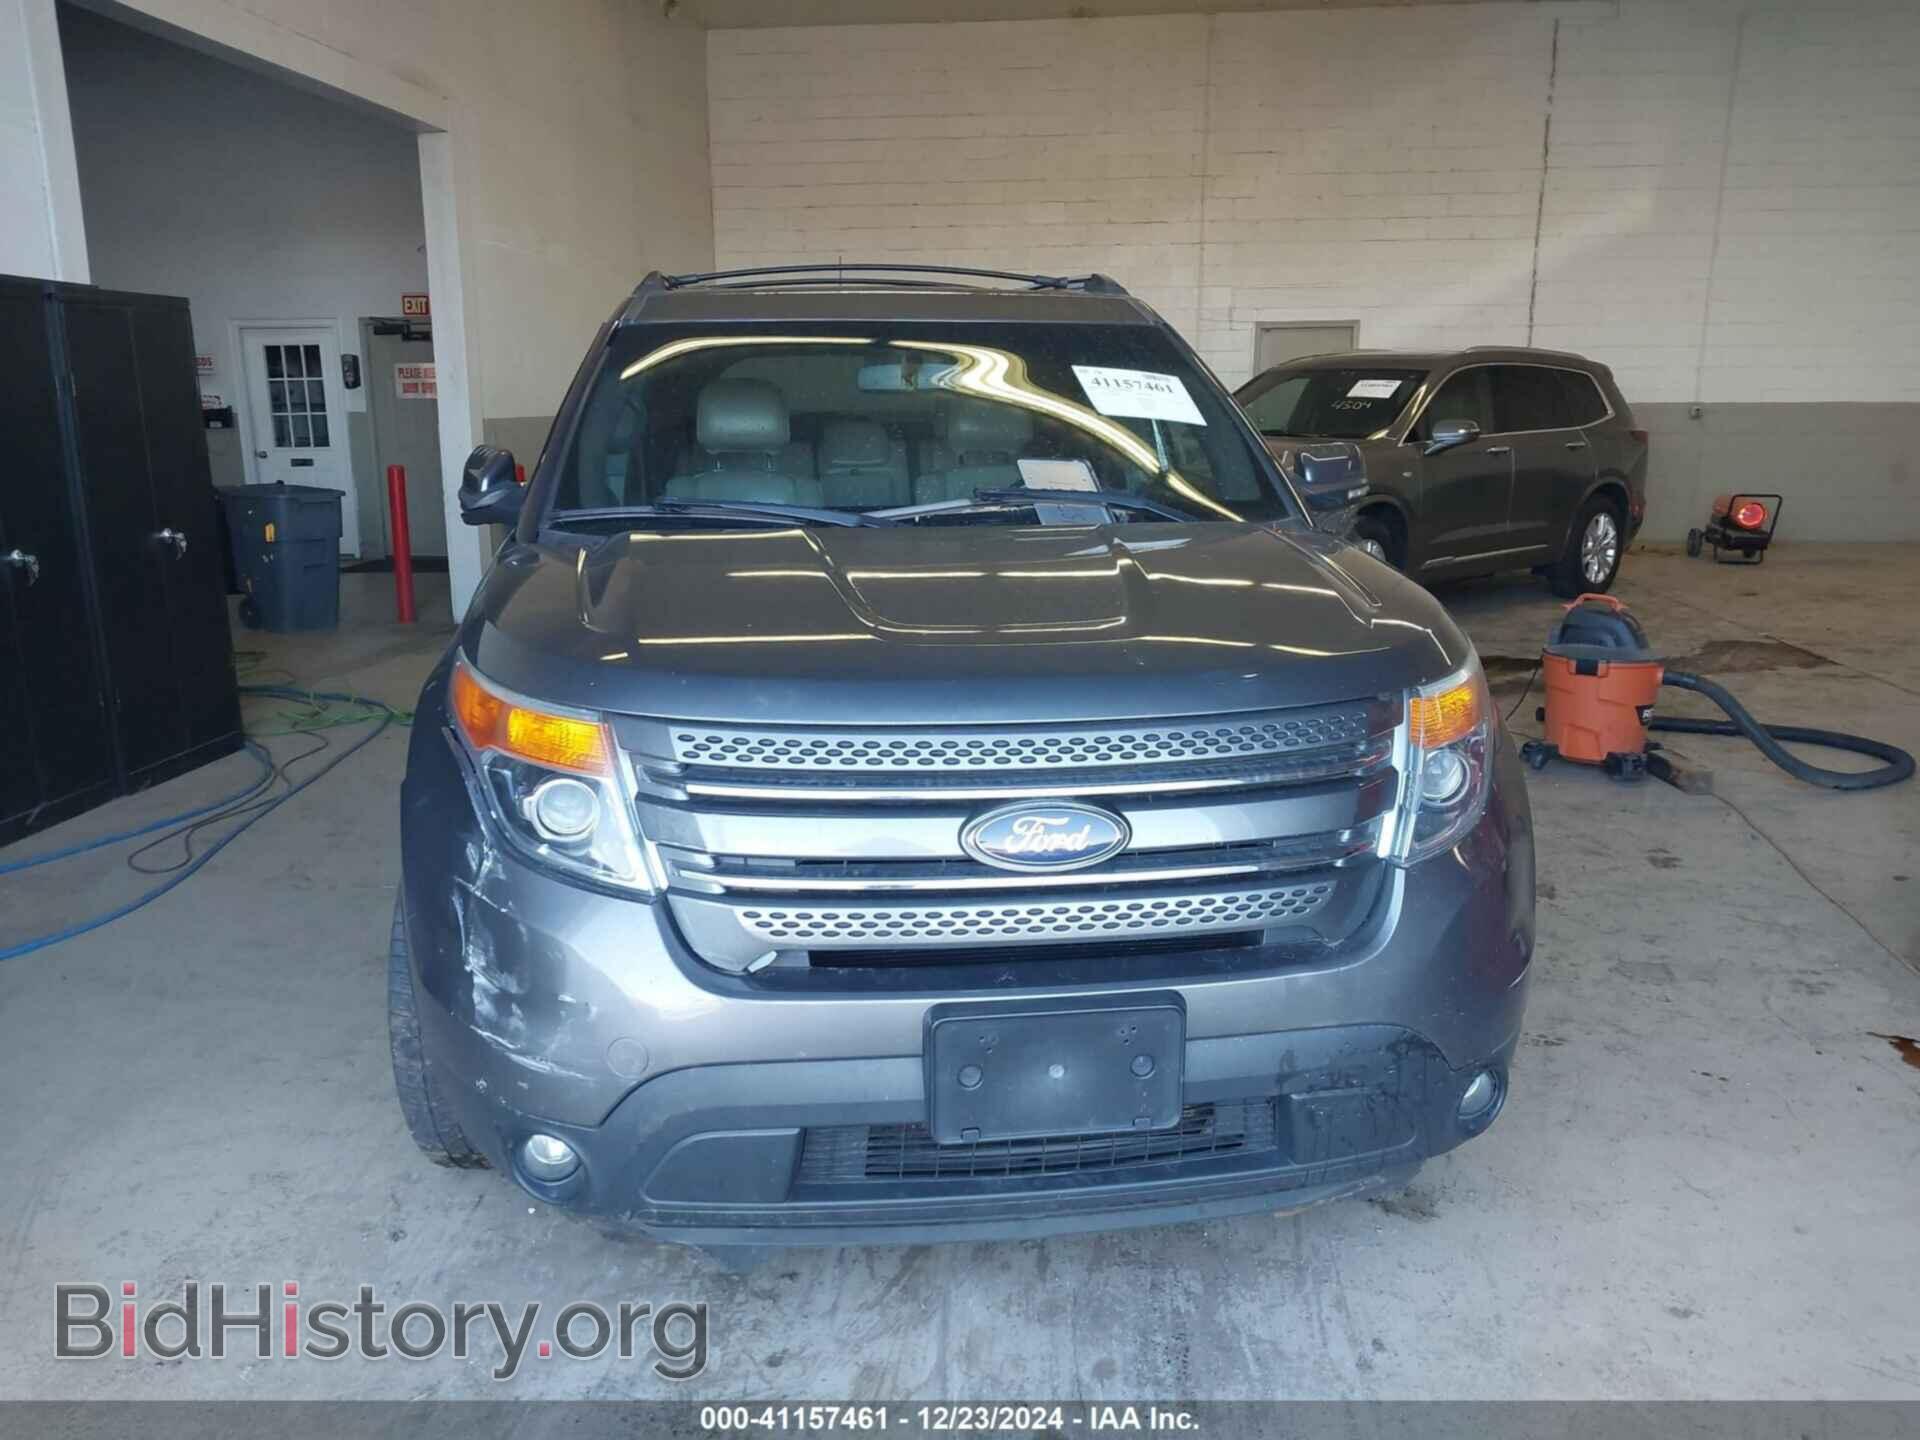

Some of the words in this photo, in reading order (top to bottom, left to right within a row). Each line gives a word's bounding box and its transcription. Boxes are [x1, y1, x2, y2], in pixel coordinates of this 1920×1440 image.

[404, 297, 427, 314] EXIT
[1091, 376, 1174, 394] 41157461
[1003, 815, 1092, 853] Ford
